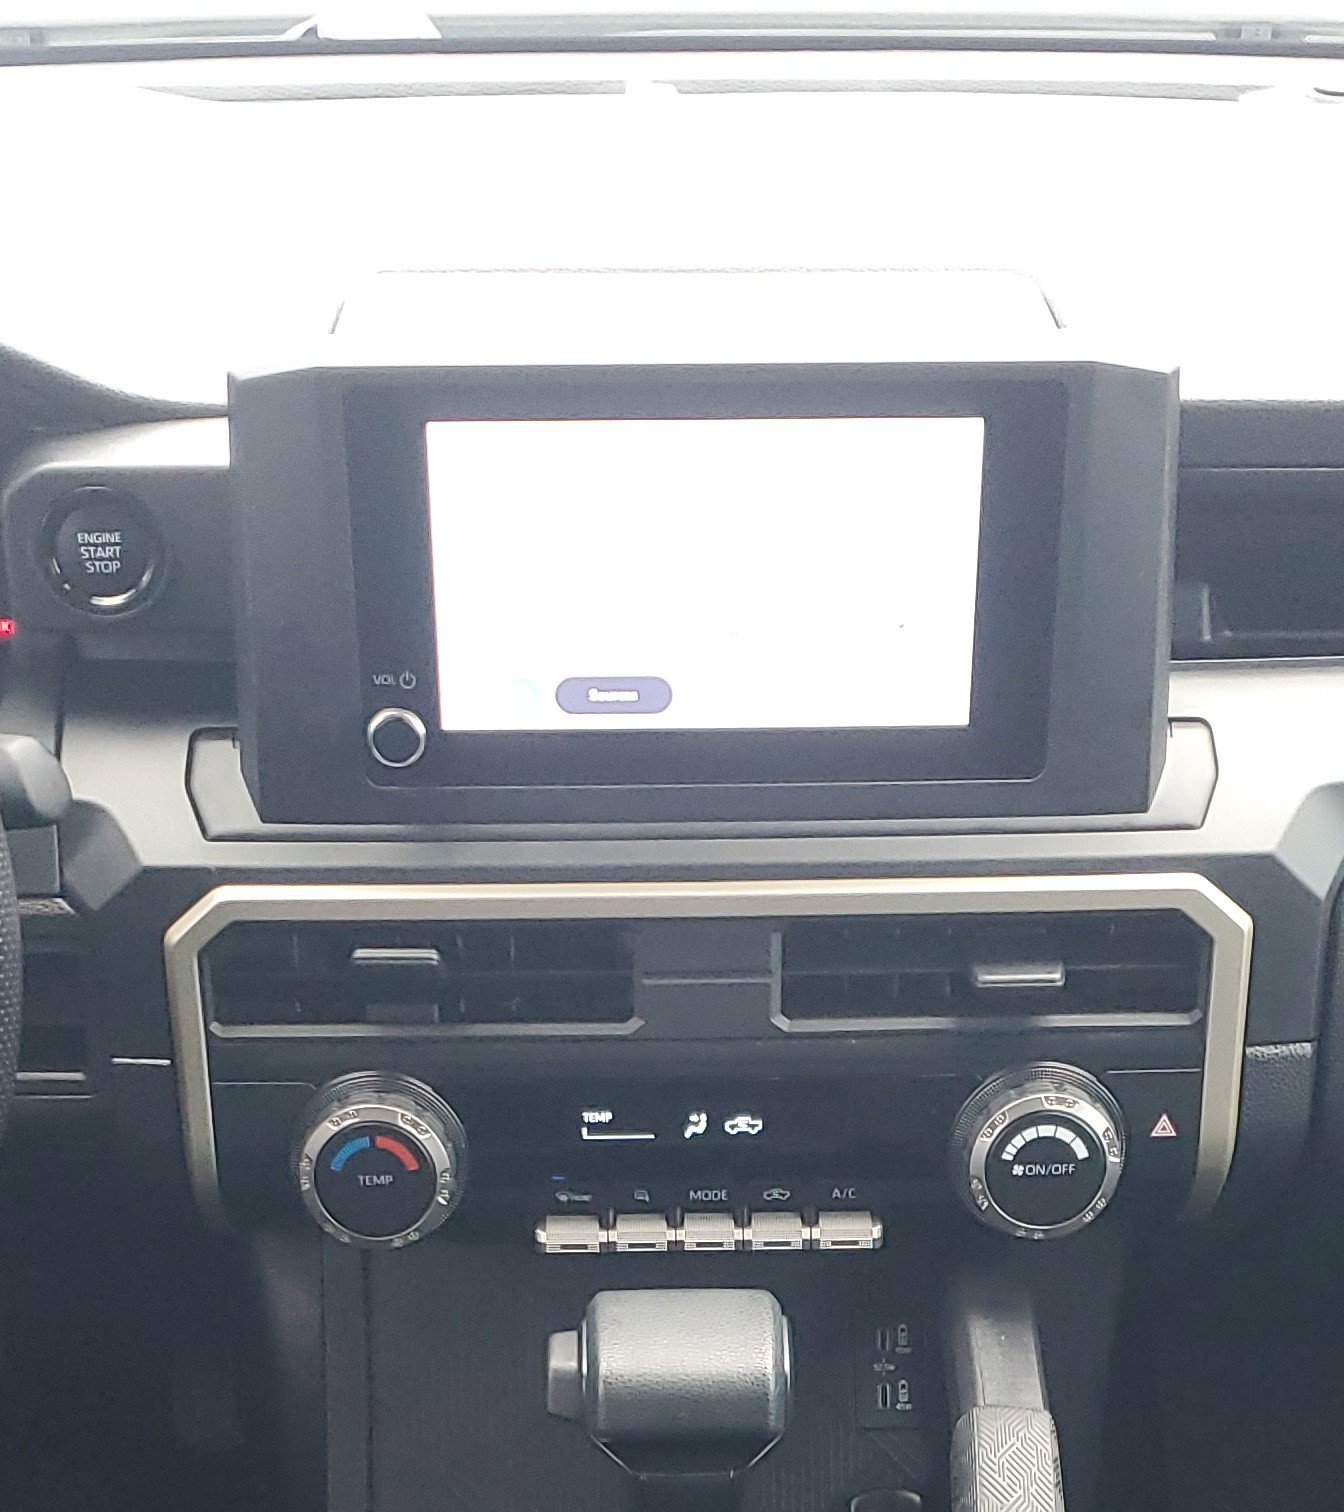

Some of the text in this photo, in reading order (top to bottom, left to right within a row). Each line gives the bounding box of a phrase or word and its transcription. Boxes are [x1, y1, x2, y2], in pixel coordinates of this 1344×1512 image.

[77, 532, 122, 544] ENGINE
[80, 546, 122, 559] START
[85, 561, 121, 573] STOP
[372, 674, 397, 686] VOL
[582, 1110, 613, 1124] TEMP
[1025, 1163, 1076, 1176] ON/OFF
[357, 1174, 394, 1188] TEMP
[689, 1188, 728, 1201] MODE
[831, 1187, 857, 1200] A/C
